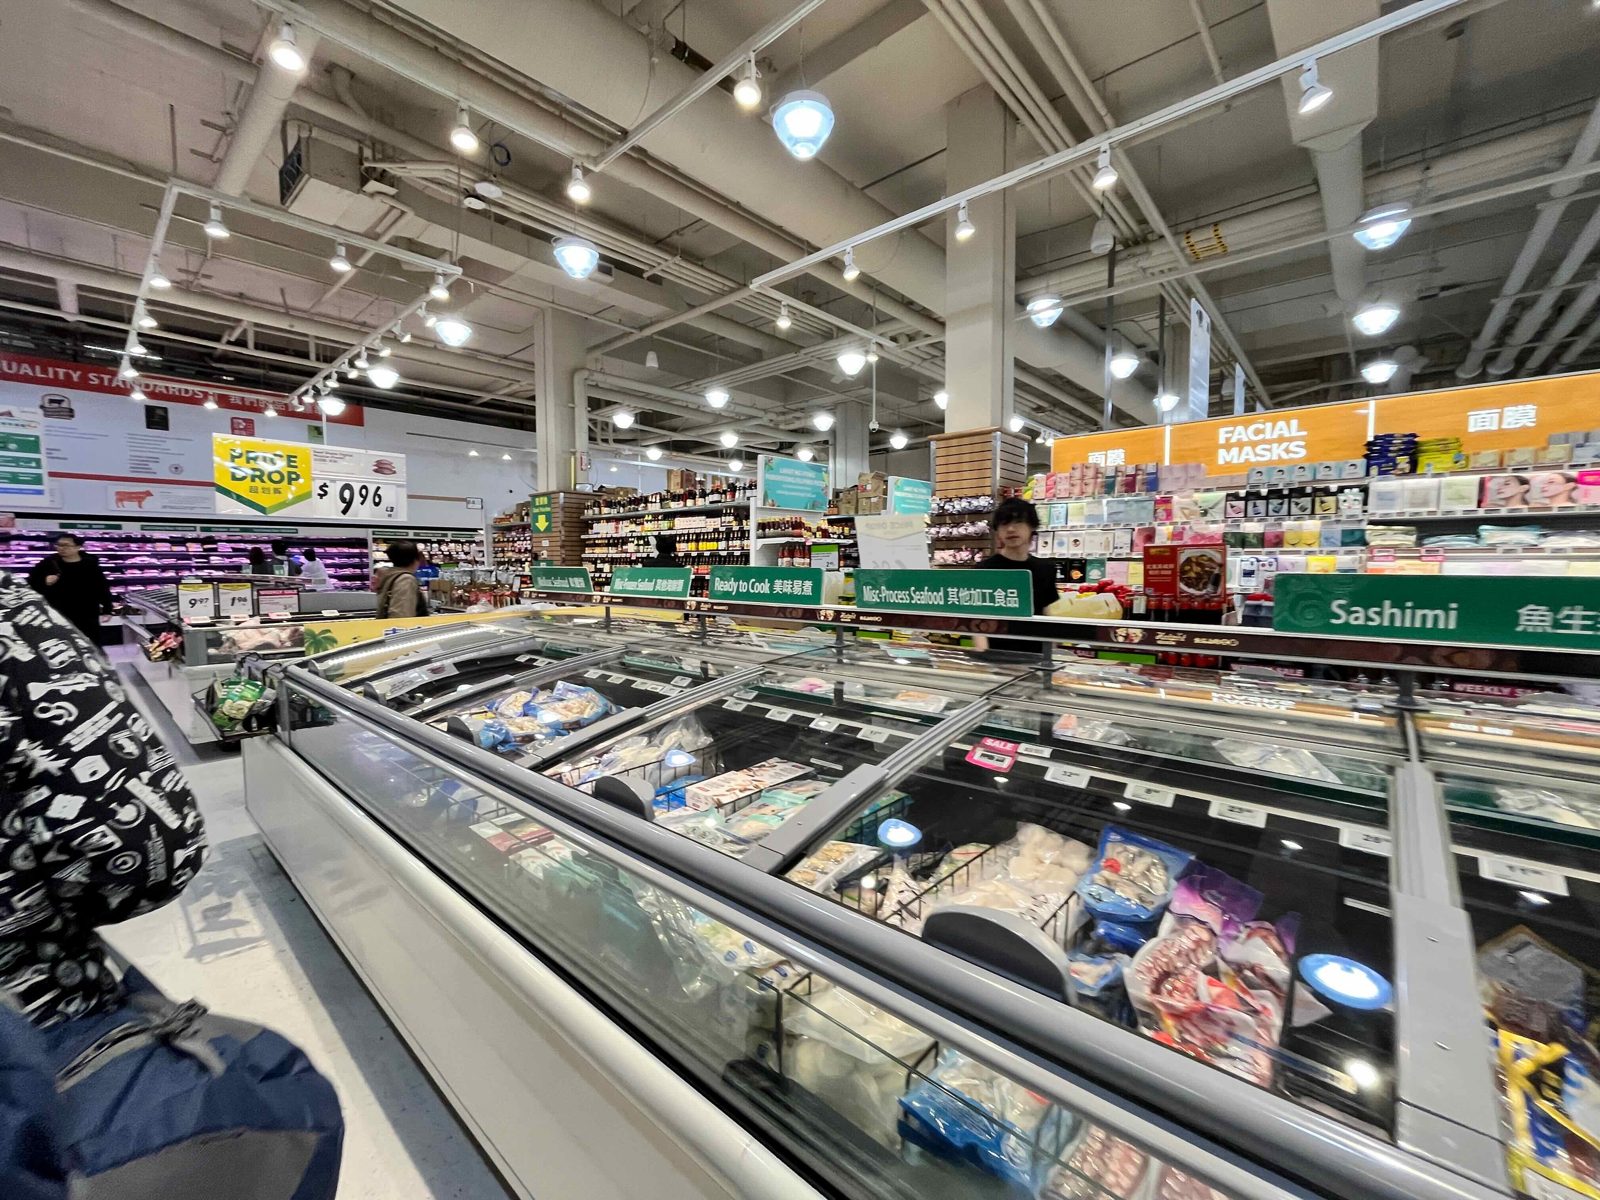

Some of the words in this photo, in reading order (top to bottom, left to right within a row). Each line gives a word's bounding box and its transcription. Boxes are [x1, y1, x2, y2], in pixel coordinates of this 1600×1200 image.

[0, 360, 82, 382] UALITY
[1467, 404, 1538, 432] 面膜
[1218, 420, 1307, 444] FACIAL
[1218, 441, 1307, 464] MASKS
[230, 466, 301, 485] DROP
[714, 577, 737, 595] Ready
[739, 580, 748, 592] to
[749, 578, 770, 593] Cook
[773, 579, 813, 595] 美味易煮
[863, 585, 910, 604] Misc-Process
[910, 587, 945, 605] Seafood
[947, 588, 1019, 607] 其他加工食品
[1329, 599, 1459, 629] Sashimi
[1515, 604, 1600, 635] 魚生
[984, 739, 1015, 750] SALE
